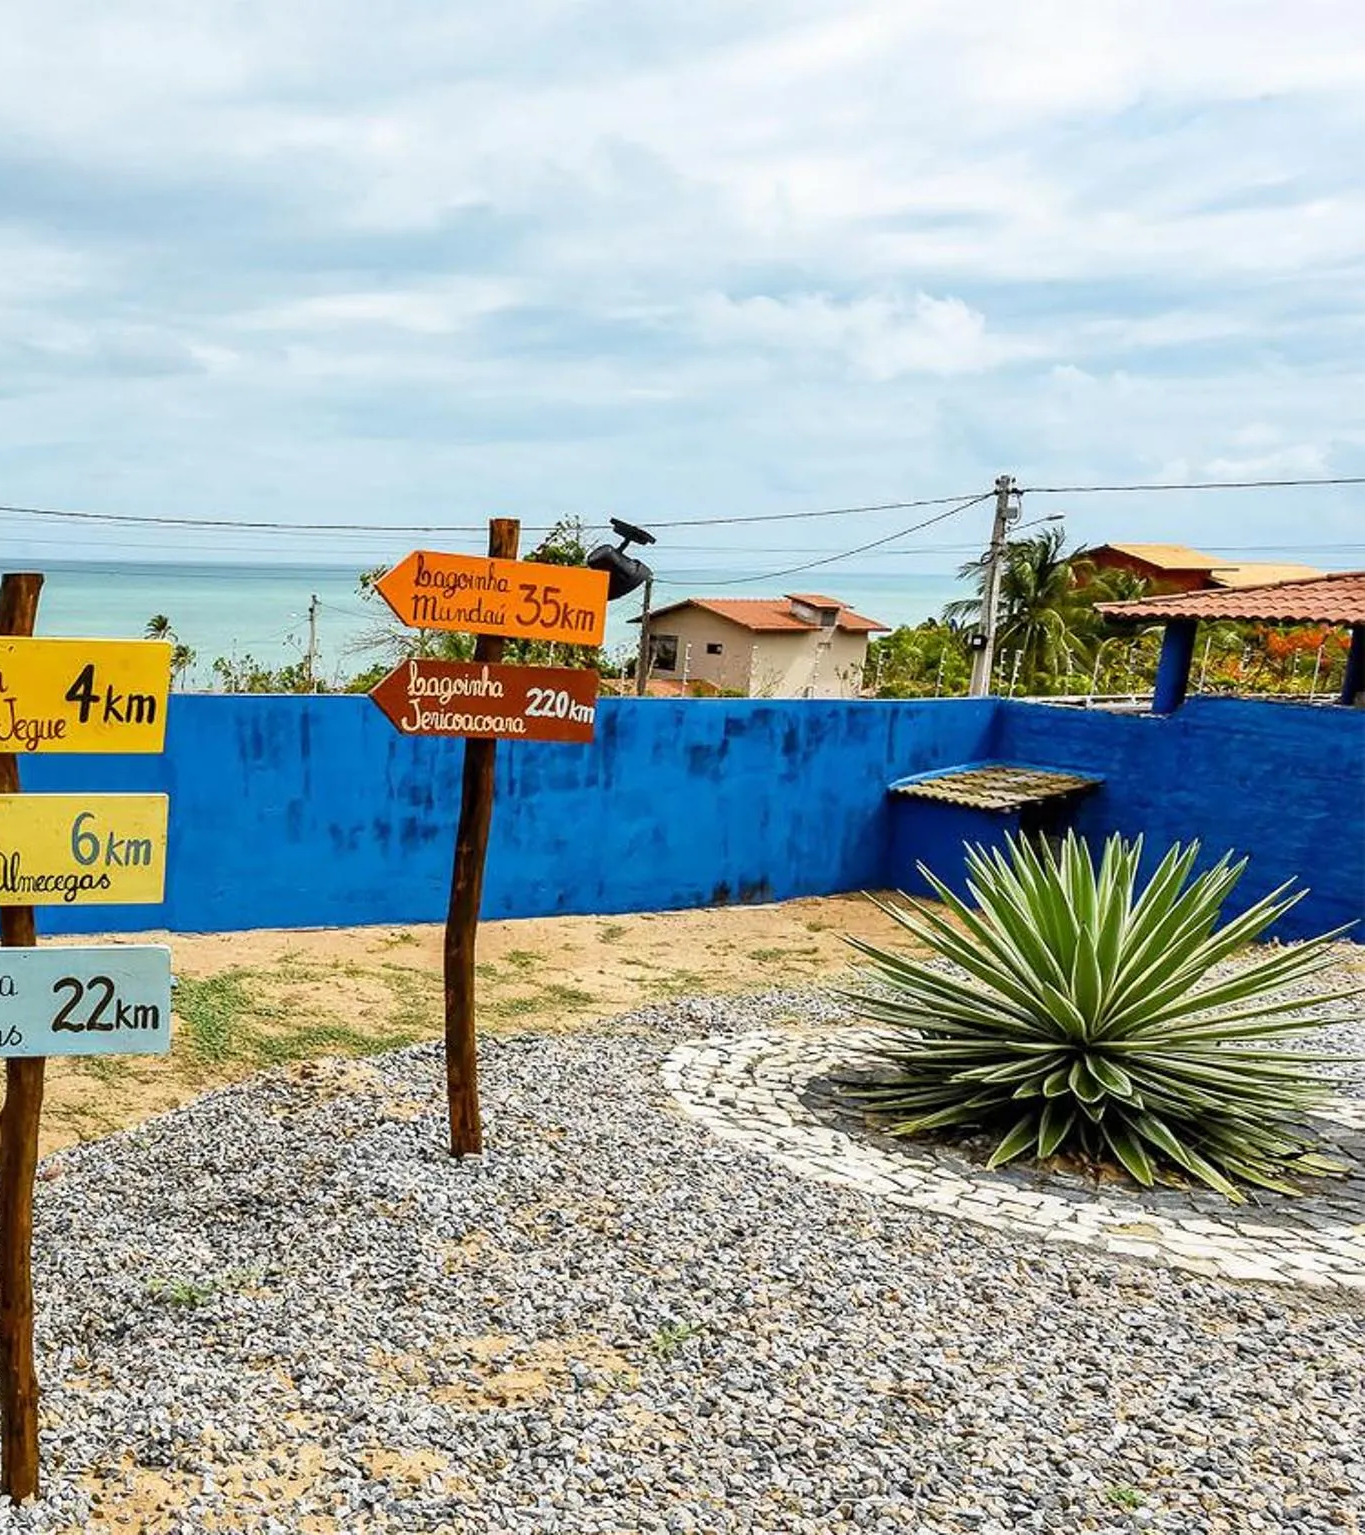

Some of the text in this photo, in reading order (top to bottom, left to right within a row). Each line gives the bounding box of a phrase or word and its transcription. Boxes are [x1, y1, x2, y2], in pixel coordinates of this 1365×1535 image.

[414, 553, 511, 598] Lagoinha
[411, 593, 507, 627] Mundaú
[407, 660, 504, 705] Lagoinha
[401, 699, 527, 733] Jericoacoara
